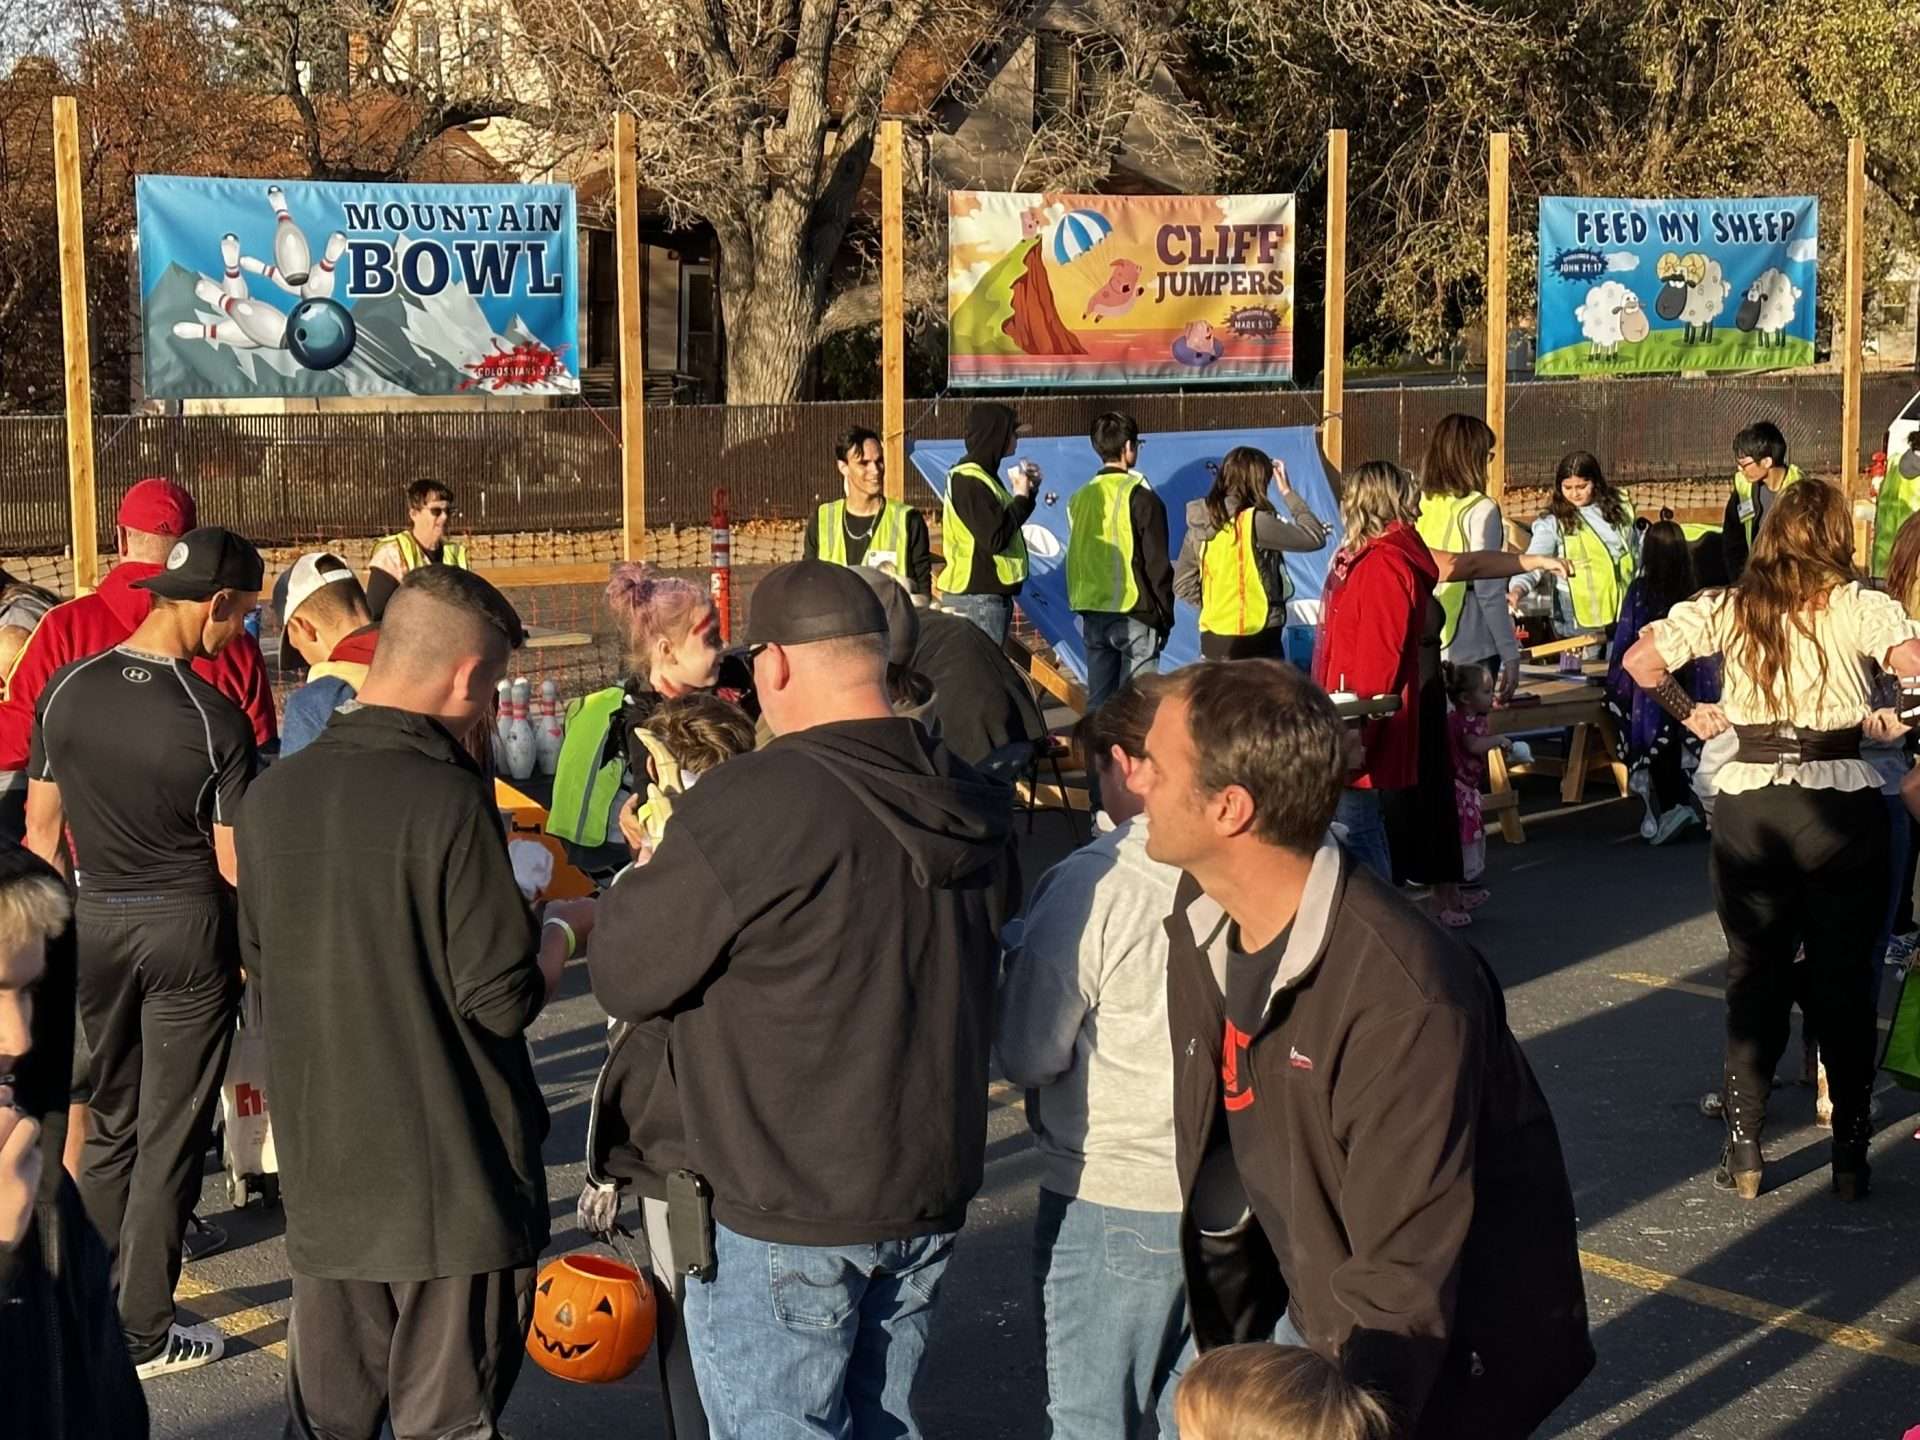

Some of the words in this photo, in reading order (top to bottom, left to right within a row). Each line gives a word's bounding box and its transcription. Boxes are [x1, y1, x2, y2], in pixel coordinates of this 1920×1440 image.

[343, 203, 563, 233] MOUNTAIN
[1576, 211, 1648, 245] FEED
[1657, 212, 1700, 244] MY
[1711, 210, 1796, 244] SHEEP
[1156, 223, 1284, 265] CLIFF
[346, 239, 563, 296] BOWL
[1560, 263, 1580, 273] JOHN
[1155, 269, 1284, 303] JUMPERS
[1234, 320, 1255, 329] MARK
[478, 367, 536, 377] COLOSSIANS
